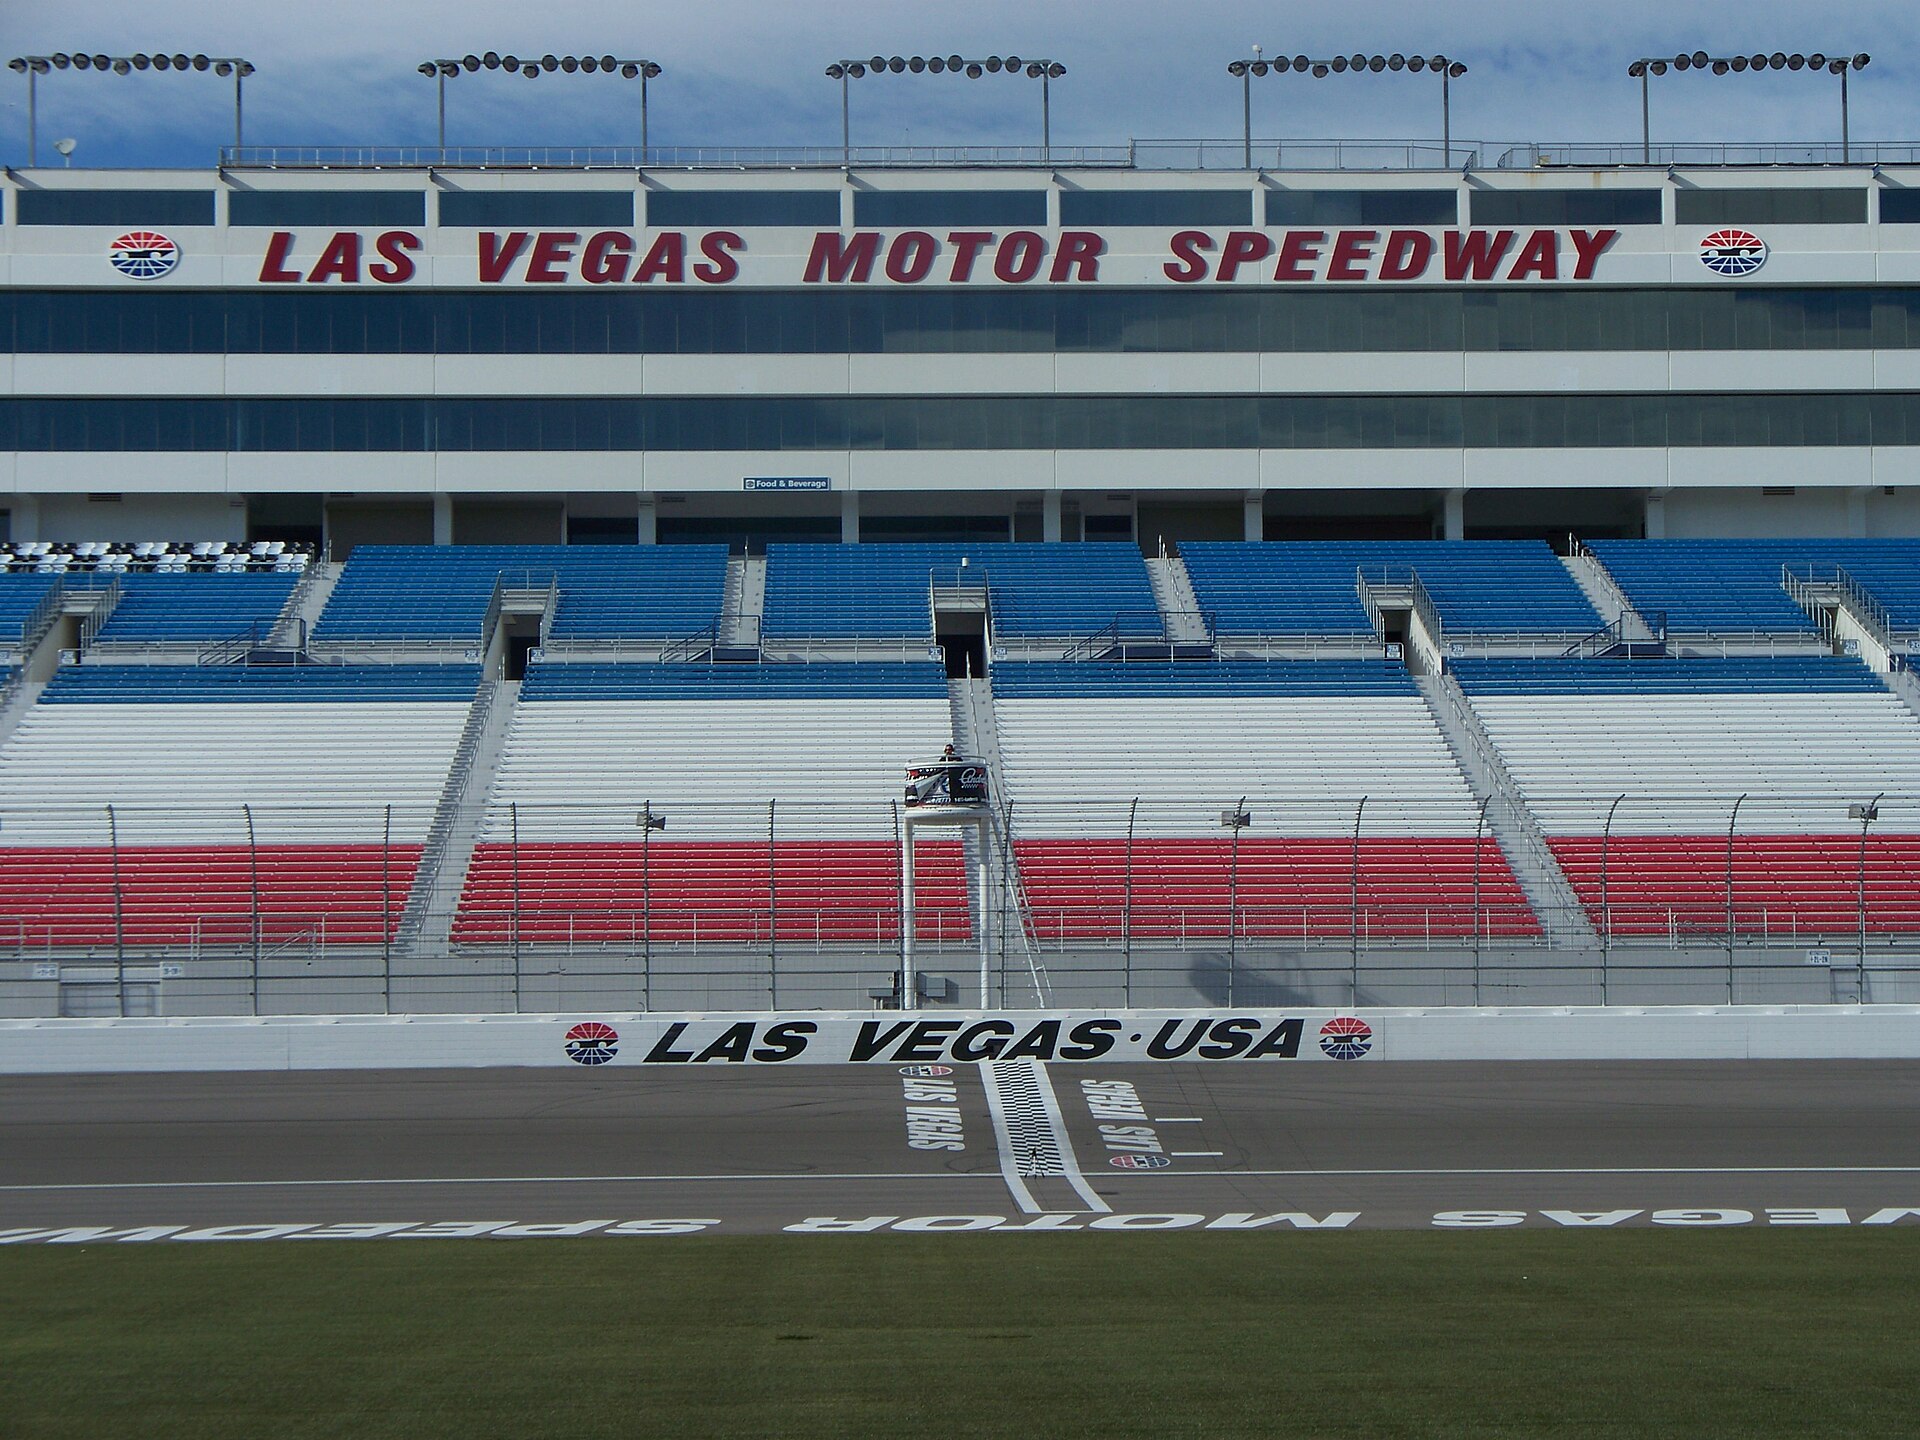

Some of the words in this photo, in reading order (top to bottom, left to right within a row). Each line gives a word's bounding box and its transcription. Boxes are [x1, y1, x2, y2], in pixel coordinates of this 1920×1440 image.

[259, 231, 419, 283] LAS
[479, 231, 743, 282] VEGAS
[803, 231, 1104, 281] MOTOR
[1164, 230, 1617, 280] SPEEDWAY
[756, 480, 777, 488] Food
[779, 480, 786, 488] &
[788, 480, 827, 489] Beverage
[642, 1022, 817, 1063] LAS
[902, 1078, 958, 1102] LAS
[1080, 1079, 1149, 1120] VEGAS
[906, 1106, 966, 1151] VEGAS
[1098, 1124, 1164, 1153] LAS
[782, 1211, 1362, 1232] MOTOR
